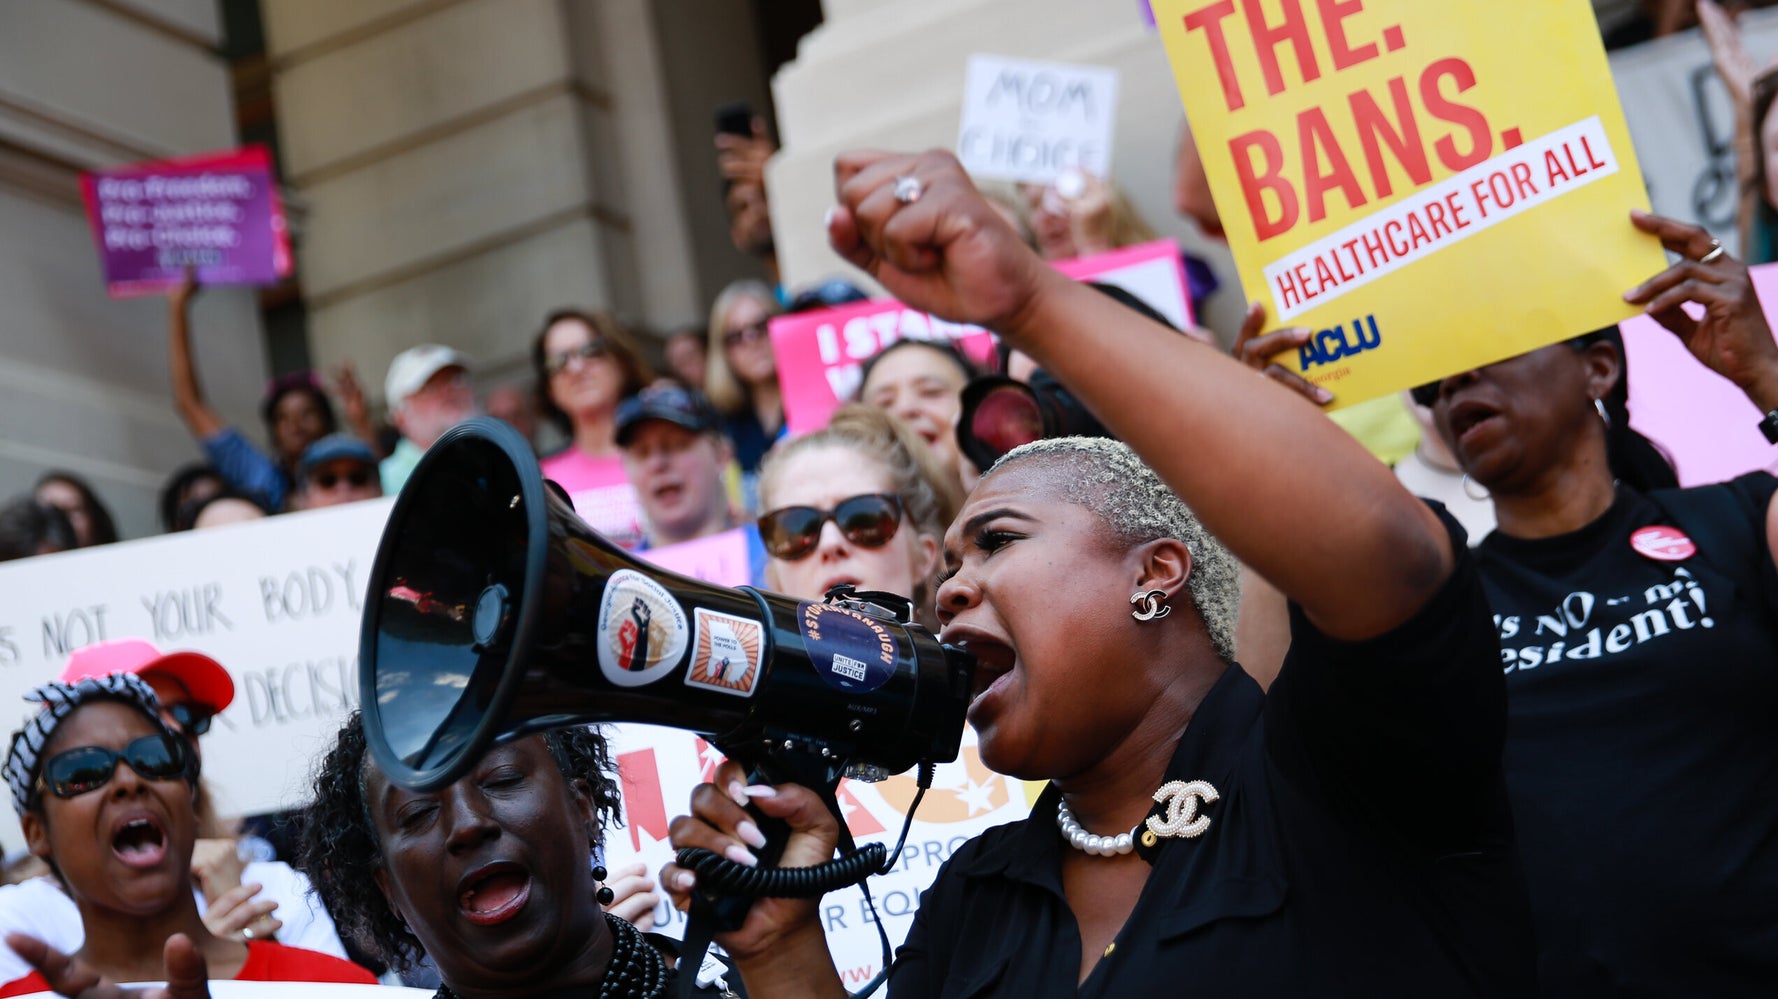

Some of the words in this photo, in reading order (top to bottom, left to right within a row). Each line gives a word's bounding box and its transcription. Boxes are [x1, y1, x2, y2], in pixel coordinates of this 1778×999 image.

[1183, 0, 1406, 112] THE.
[985, 69, 1096, 123] MOM
[961, 125, 1101, 170] CHOICE
[1228, 56, 1523, 243] BANS.
[1276, 191, 1471, 310] HEALTHCARE
[1470, 161, 1539, 218] FOR
[1543, 136, 1606, 188] ALL
[816, 323, 840, 365] I
[1299, 314, 1381, 371] ACLU
[41, 603, 109, 660] NOT
[140, 582, 234, 642] YOUR
[258, 558, 362, 624] BODY
[243, 654, 361, 728] DECISI
[833, 665, 864, 680] JUSTICE
